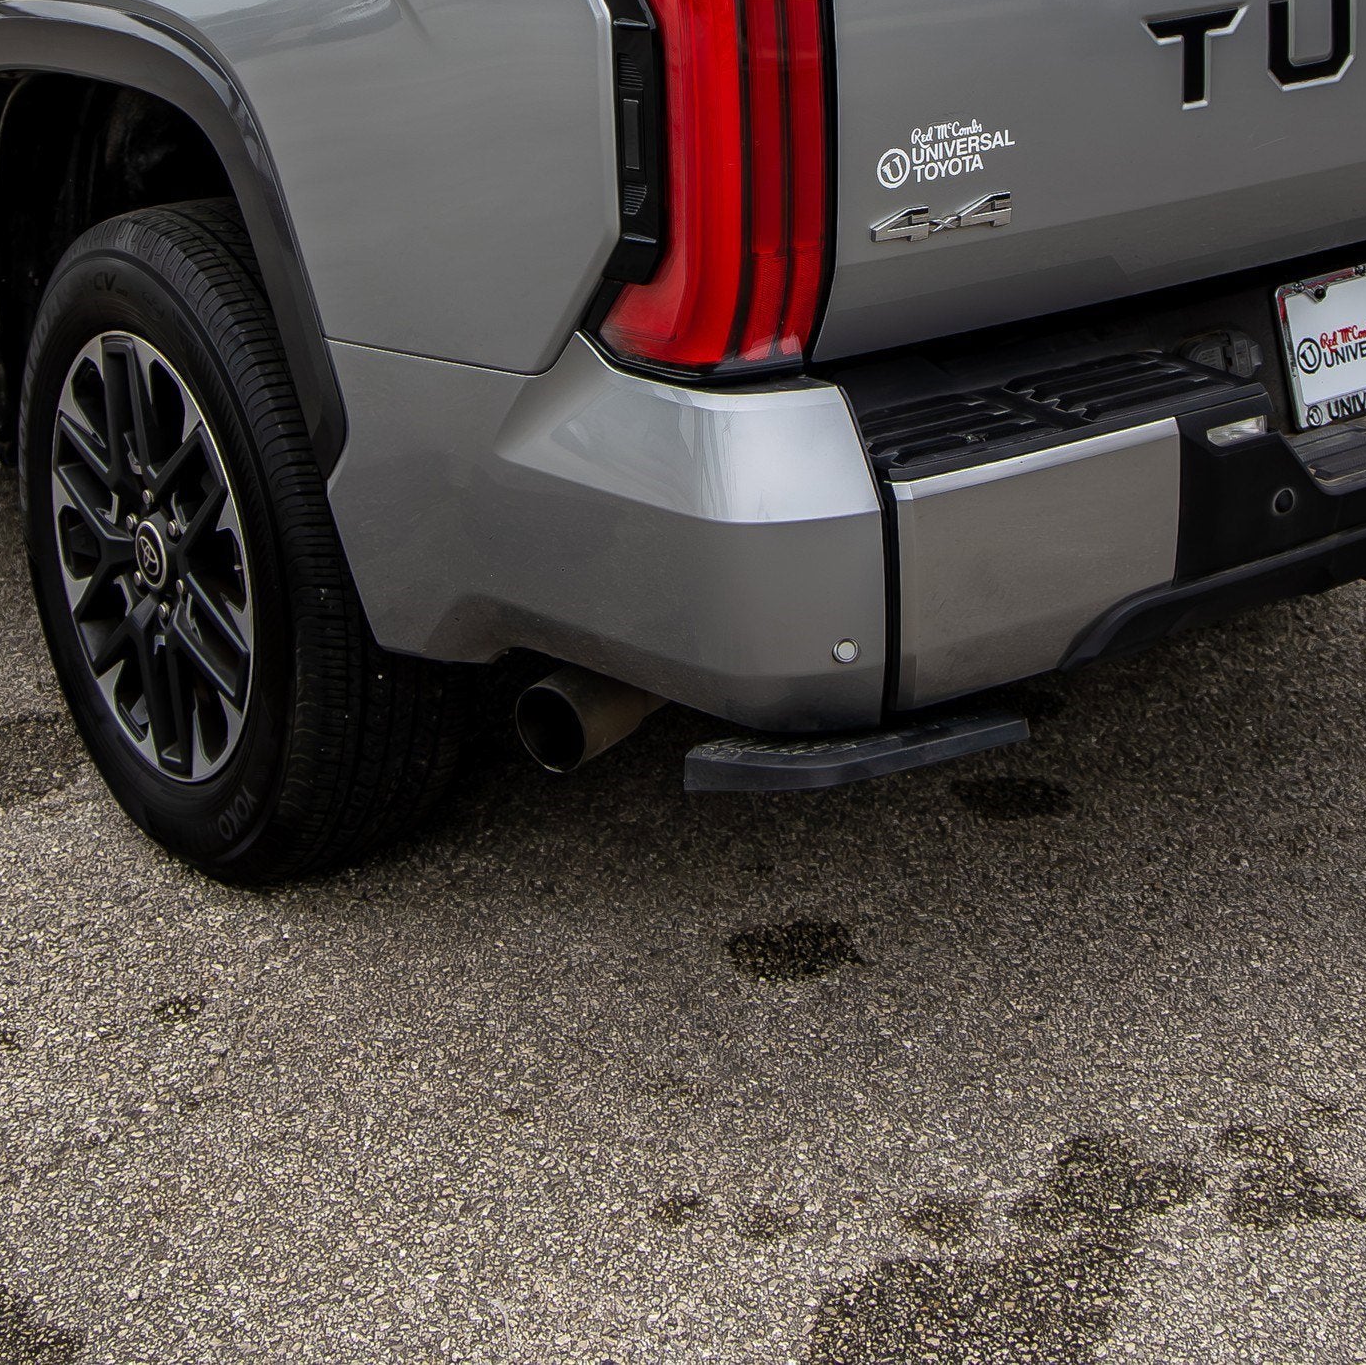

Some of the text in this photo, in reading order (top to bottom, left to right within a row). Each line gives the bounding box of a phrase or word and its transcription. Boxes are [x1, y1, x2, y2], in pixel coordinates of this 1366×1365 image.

[911, 119, 982, 145] Red McCombs
[911, 129, 1015, 165] UNIVERSAL
[913, 154, 984, 183] TOYOTA
[870, 191, 1012, 242] 4x4
[1320, 332, 1339, 354] Red
